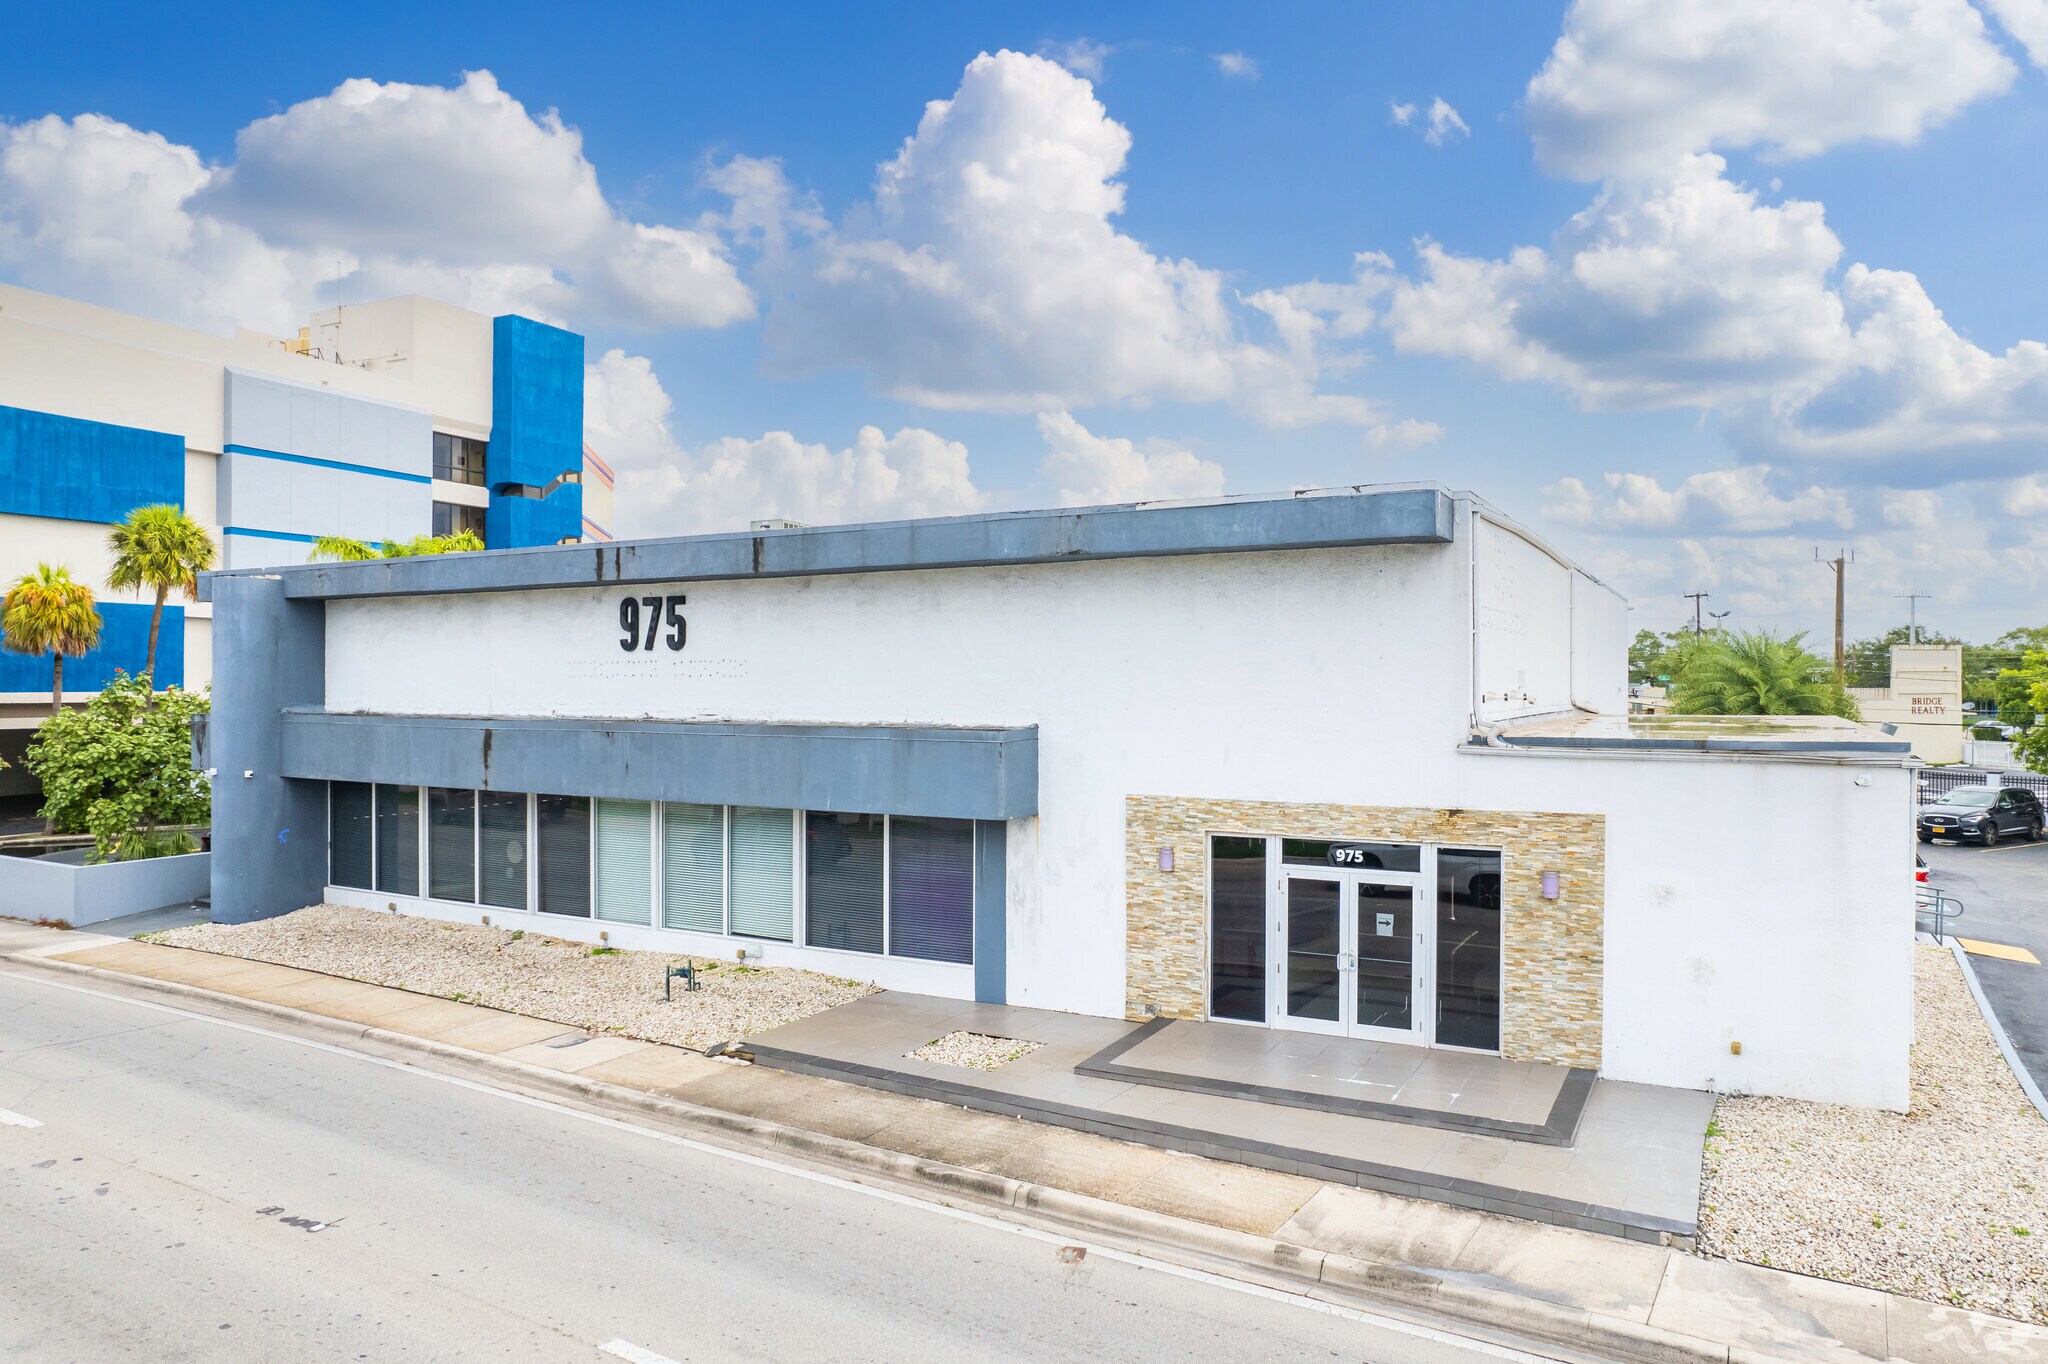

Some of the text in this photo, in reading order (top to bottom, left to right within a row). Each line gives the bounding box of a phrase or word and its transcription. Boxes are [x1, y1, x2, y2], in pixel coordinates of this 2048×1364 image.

[620, 595, 686, 652] 975
[1912, 697, 1943, 705] BRIDGE
[1912, 706, 1945, 714] REALTY
[1336, 849, 1363, 862] 975
